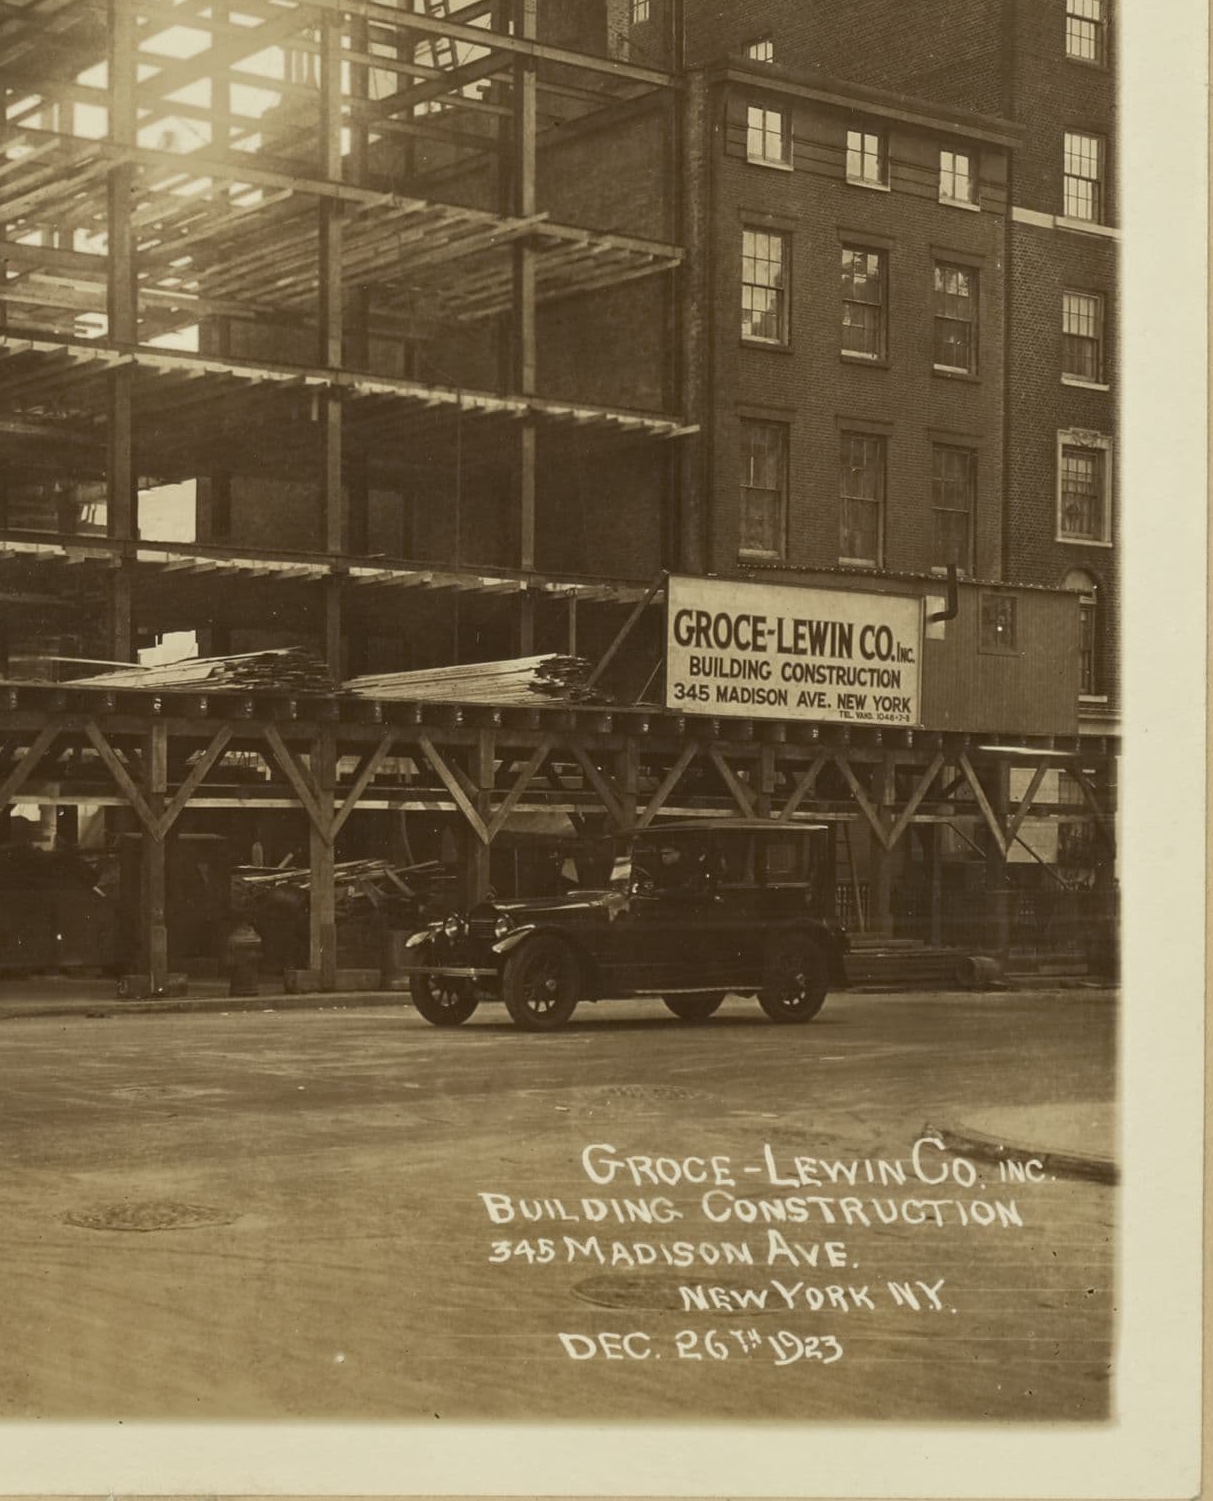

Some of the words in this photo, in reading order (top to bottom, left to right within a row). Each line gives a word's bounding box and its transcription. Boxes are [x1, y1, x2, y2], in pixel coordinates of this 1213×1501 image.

[673, 608, 855, 659] GROCE-LEWIN
[859, 625, 896, 663] CO.
[689, 656, 772, 680] BUILDING
[781, 662, 901, 689] CONSTRUCTION
[673, 683, 710, 701] 345
[716, 685, 788, 706] MADISON
[797, 691, 832, 708] AVE.
[837, 693, 869, 711] NEW
[873, 696, 912, 714] YORK
